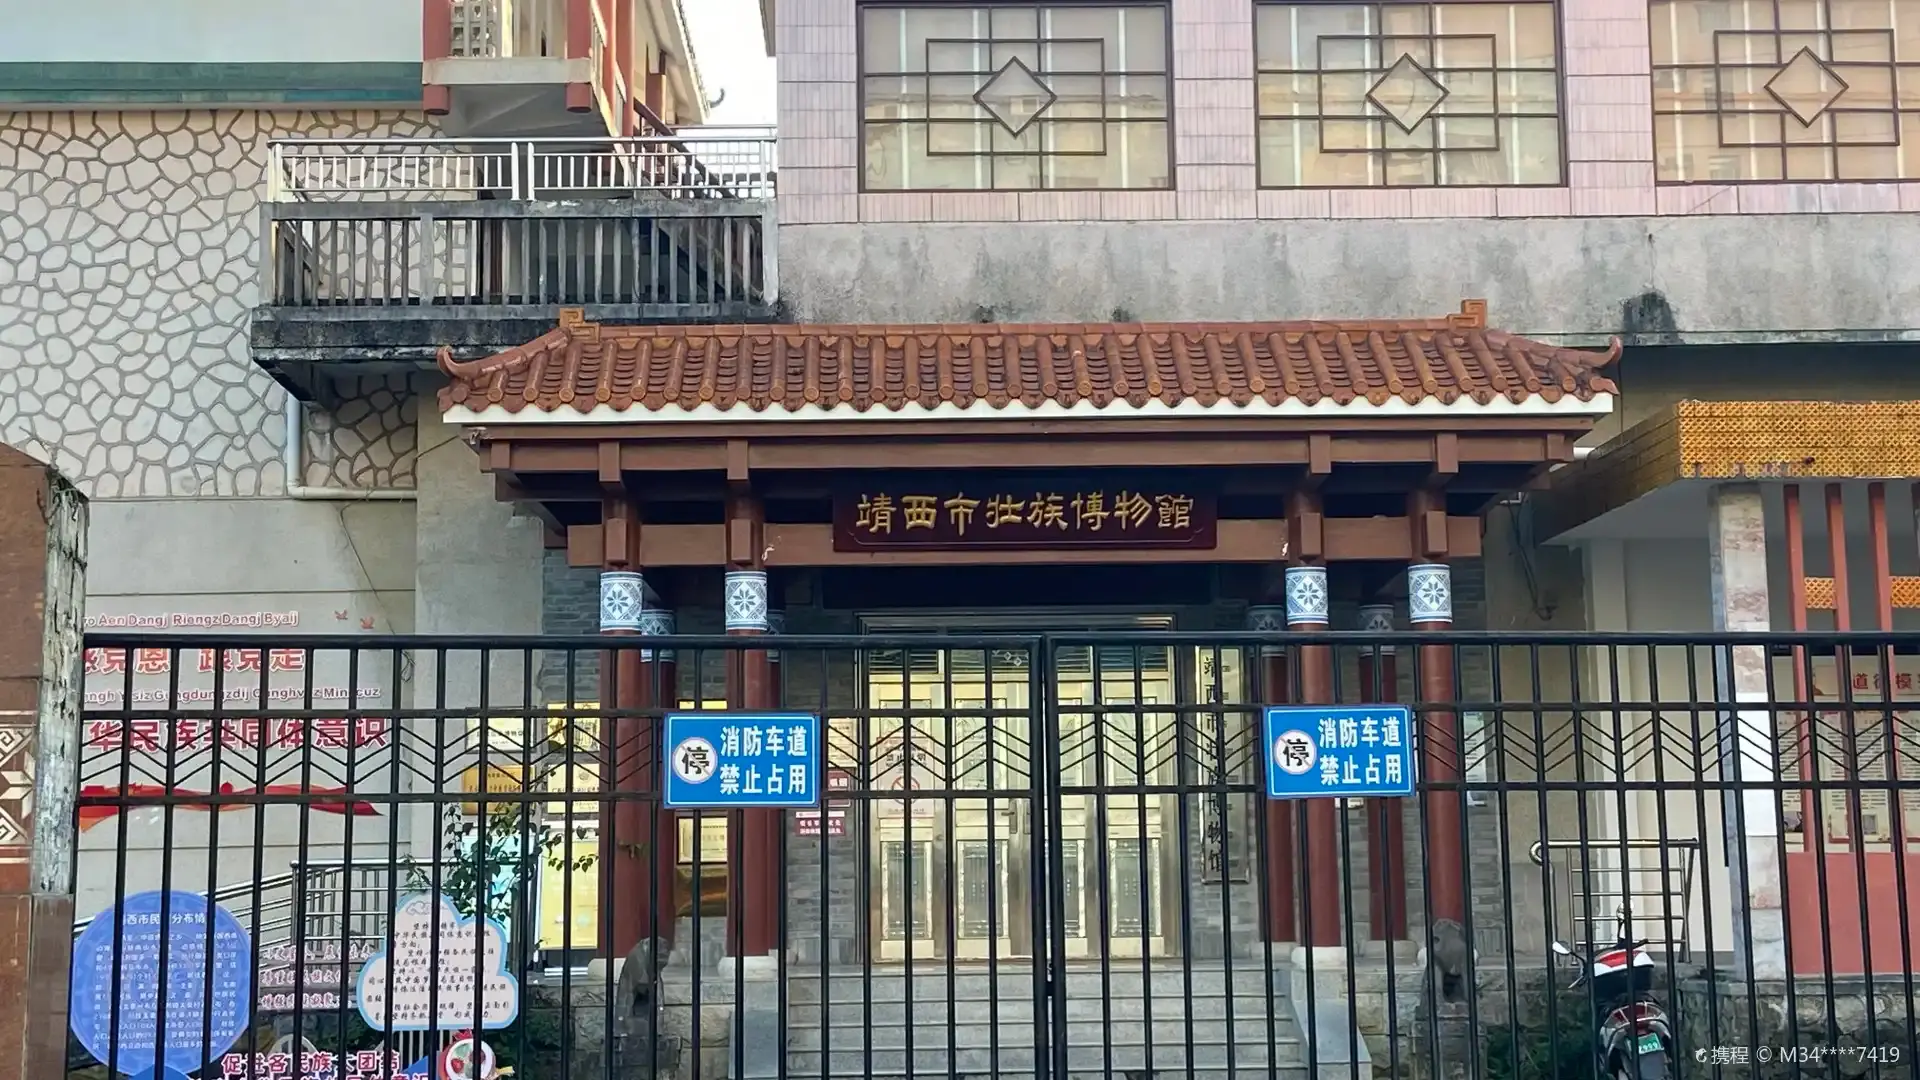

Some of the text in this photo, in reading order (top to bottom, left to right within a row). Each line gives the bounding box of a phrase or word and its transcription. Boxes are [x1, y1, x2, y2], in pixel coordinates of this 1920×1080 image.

[99, 614, 126, 626] Aen
[128, 614, 168, 628] Dangj
[173, 614, 220, 628] Riengz
[222, 613, 262, 628] Dangj
[264, 611, 299, 627] Byaij
[324, 687, 380, 700] Mincuz
[719, 725, 807, 757] 消防车道
[1318, 716, 1401, 748] 消防车道
[681, 746, 709, 774] 停
[1283, 738, 1309, 766] 停
[719, 763, 806, 794] 禁止占用
[1320, 754, 1402, 786] 禁止占用
